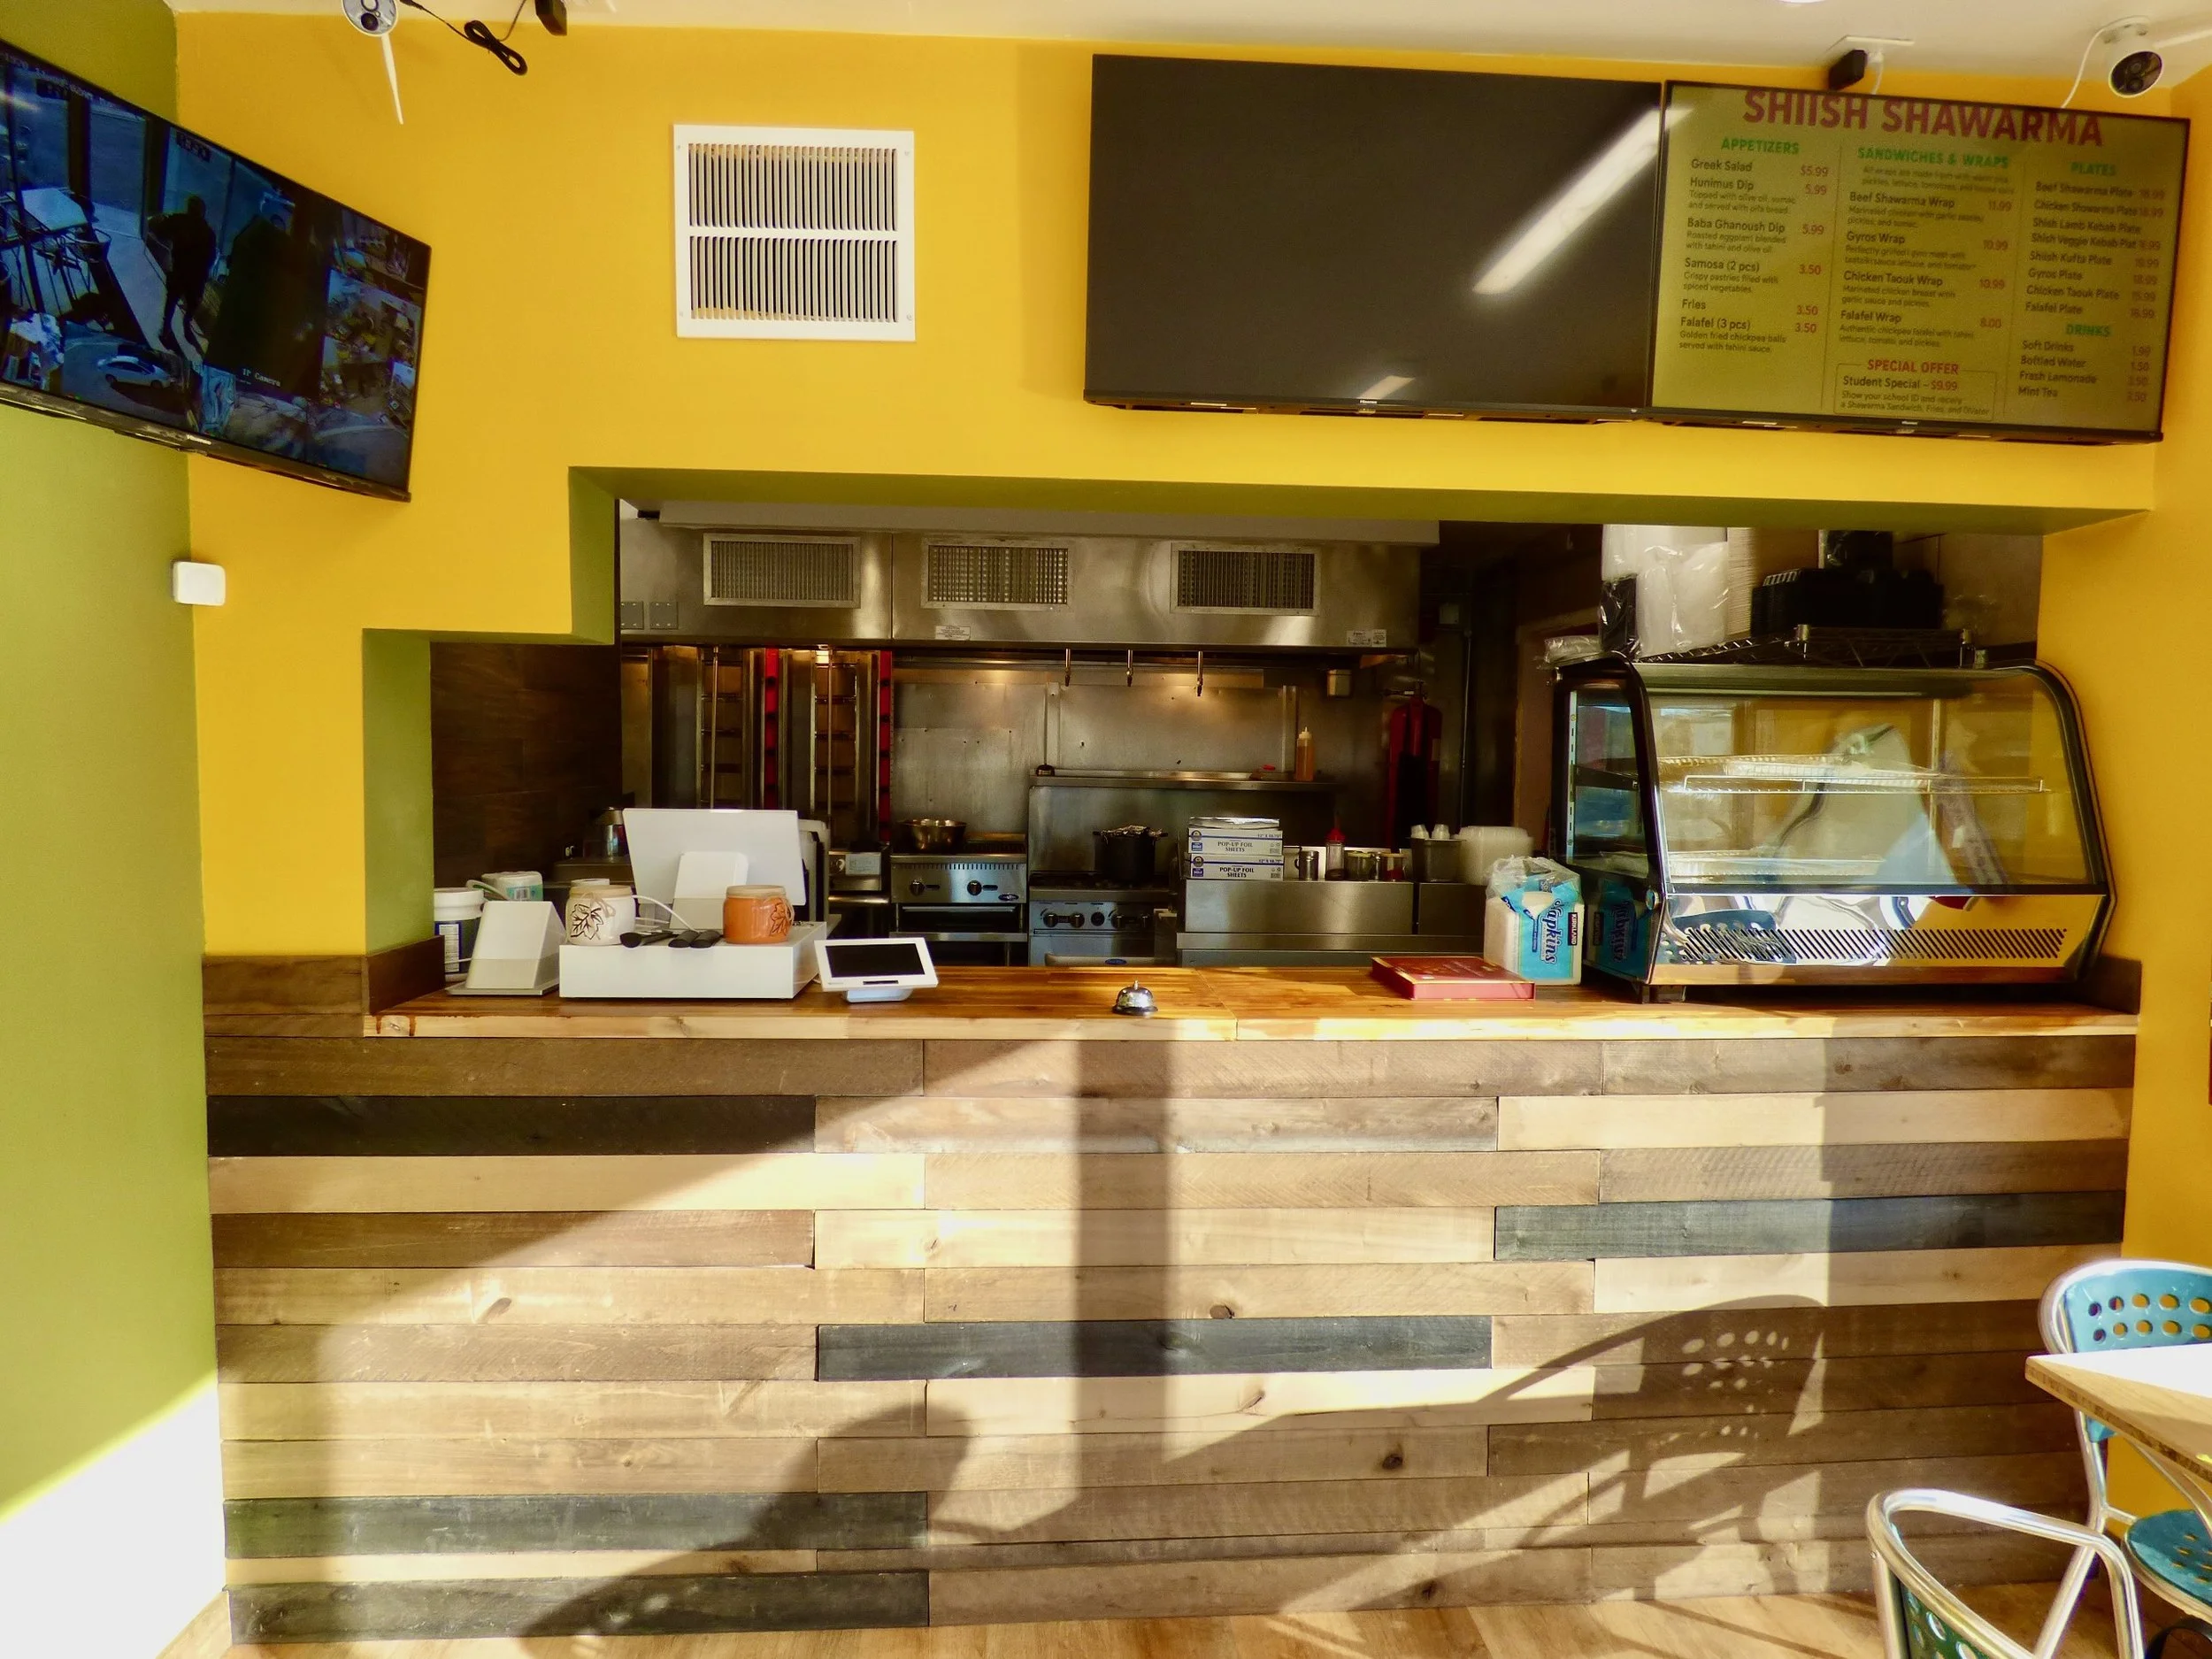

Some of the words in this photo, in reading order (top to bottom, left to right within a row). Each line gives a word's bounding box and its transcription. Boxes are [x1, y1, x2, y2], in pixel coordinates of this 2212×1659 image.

[1743, 91, 1868, 130] SHIISH
[1882, 98, 2102, 146] SHAWARMA
[1721, 139, 1799, 154] APPETIZERS
[1857, 147, 1944, 165] SANDWICHES
[1947, 153, 1957, 165] &
[1962, 154, 2008, 168] WRAPS
[1692, 158, 1721, 170] Greek
[1724, 161, 1752, 172] Salad
[1801, 165, 1828, 176] $5.99
[2071, 162, 2116, 176] PLATES
[1737, 180, 1754, 192] Dip
[1805, 184, 1826, 195] 5.99
[2036, 180, 2057, 192] Beef
[2060, 182, 2108, 195] Shawarma
[1850, 191, 1872, 202] Beef
[1876, 194, 1926, 206] Shawarma
[1929, 196, 1955, 209] Wrap
[1988, 200, 2012, 211] 11.99
[2034, 199, 2070, 210] Chicken
[2072, 202, 2115, 214] Shawarma
[1687, 218, 1712, 228] Baba
[1716, 219, 1764, 232] Ghanoush
[1769, 222, 1785, 234] Dip
[1802, 224, 1824, 234] 5.99
[2033, 218, 2057, 227] Shish
[2060, 220, 2085, 230] Lamb
[1719, 233, 1753, 242] eggplant
[1755, 234, 1786, 243] blended
[1847, 231, 1877, 243] Gyros
[1879, 233, 1905, 244] Wrap
[2058, 234, 2088, 248] Veggie
[1846, 245, 1879, 256] Perfectly
[1685, 257, 1724, 269] Samosa
[1727, 260, 1735, 270] (2
[1740, 262, 1759, 273] pcs)
[1799, 265, 1821, 275] 3.50
[2088, 255, 2112, 265] Plate
[1684, 272, 1708, 281] Crispy
[1710, 273, 1740, 283] pastries
[1844, 270, 1883, 282] Chicken
[1886, 273, 1914, 285] Taouk
[1917, 275, 1943, 287] Wrap
[2028, 267, 2056, 280] Gyros
[2059, 270, 2083, 280] Plate
[2026, 285, 2064, 296] Chicken
[2068, 287, 2093, 297] Taouk
[2096, 288, 2120, 300] Plate
[1682, 299, 1706, 310] Fries
[1796, 304, 1818, 315] 3.50
[2025, 302, 2056, 312] Falafel
[2059, 303, 2083, 315] Plate
[1840, 310, 1872, 320] Falafel
[1876, 312, 1901, 324] Wrap
[1681, 317, 1714, 327] Falafel
[1717, 319, 1726, 329] (3
[1730, 319, 1750, 331] pcs)
[1795, 323, 1816, 333] 3.50
[2066, 324, 2110, 337] DRINKS
[1679, 330, 1708, 340] Golden
[1710, 332, 1728, 341] fried
[1731, 334, 1765, 343] chickpea
[1768, 334, 1786, 343] balls
[2022, 340, 2042, 350] Soft
[2045, 342, 2074, 352] Drinks
[1867, 359, 1917, 373] SPECIAL
[1921, 362, 1959, 374] OFFER
[2021, 356, 2055, 366] Bottled
[2058, 357, 2086, 367] Water
[255, 373, 280, 387] Camera
[1843, 375, 1882, 388] Student
[1885, 378, 1920, 390] Special
[1931, 380, 1958, 391] $9.99
[2020, 371, 2045, 381] Fresh
[2048, 373, 2097, 384] Lemonade
[1842, 390, 1863, 399] Show
[1883, 392, 1909, 401] school
[2018, 386, 2040, 396] Mint
[2042, 388, 2058, 397] Tea
[1542, 900, 1564, 964] Napkins
